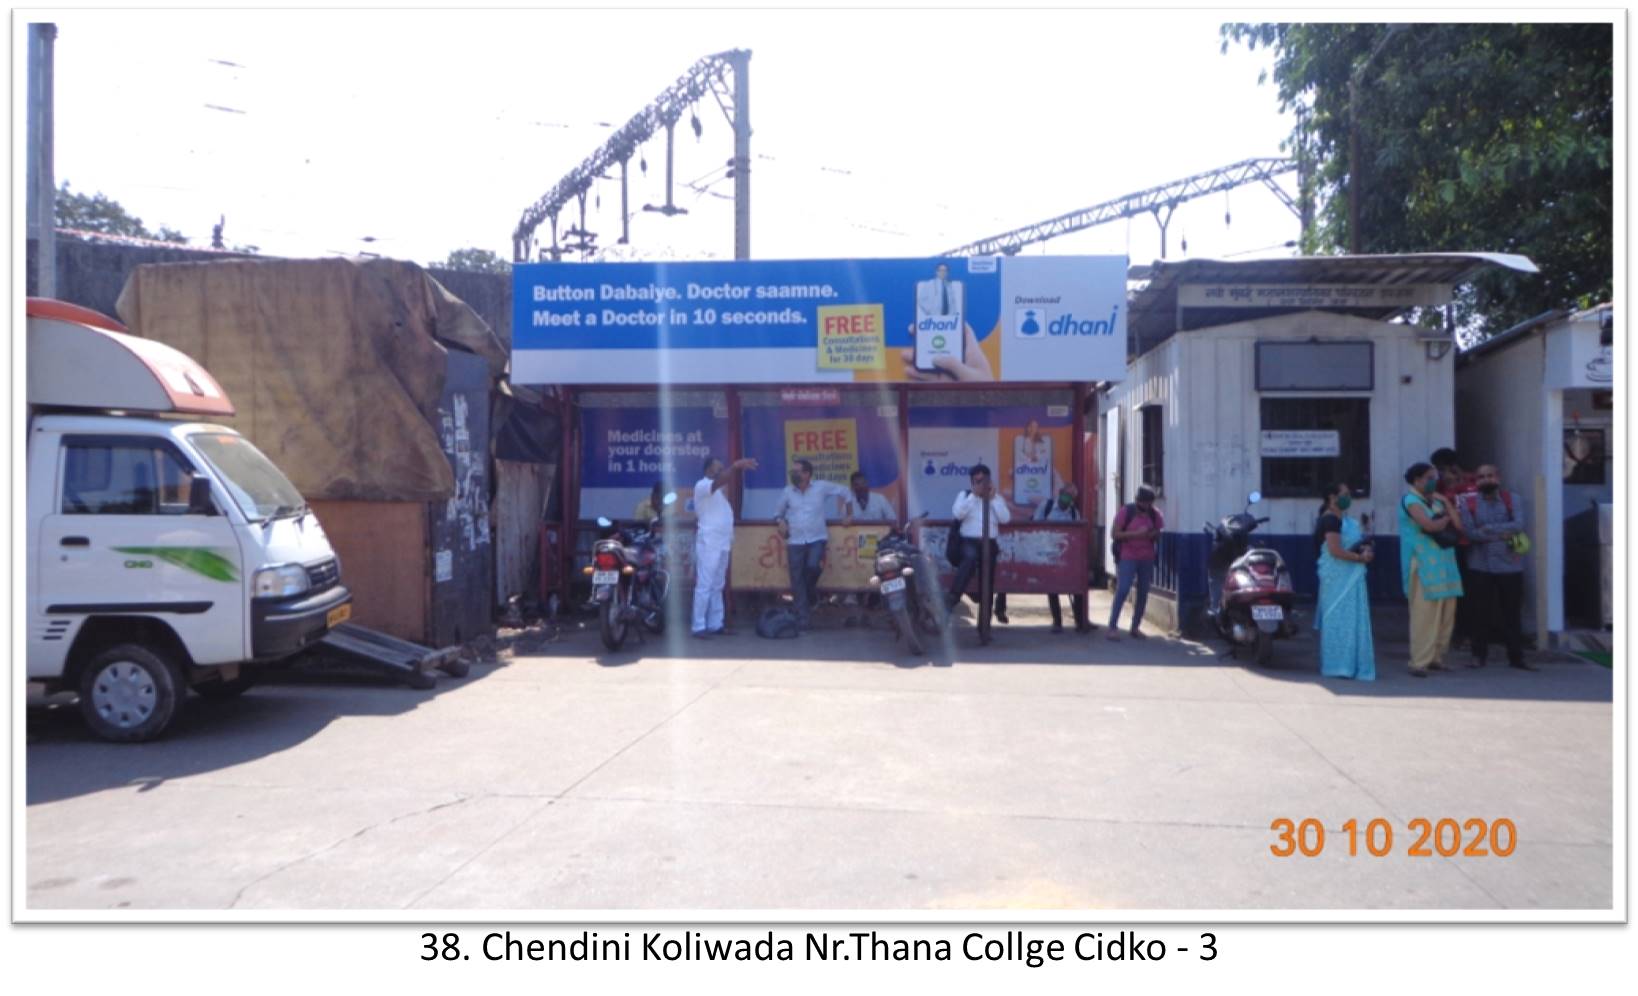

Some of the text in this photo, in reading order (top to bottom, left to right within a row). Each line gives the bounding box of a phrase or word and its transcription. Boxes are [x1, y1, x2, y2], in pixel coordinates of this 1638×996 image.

[532, 283, 839, 305] Button Dabaiye. Doctor saamne.
[1014, 295, 1061, 305] Download
[532, 307, 807, 327] Meet a Doctor in 10 seconds.
[824, 313, 876, 337] FREE
[918, 311, 960, 331] dhani
[1048, 304, 1119, 336] dhani
[607, 429, 704, 443] Medicines at
[793, 430, 849, 451] FREE
[608, 443, 711, 458] your doorstep
[608, 460, 622, 473] in
[626, 460, 636, 472] 1
